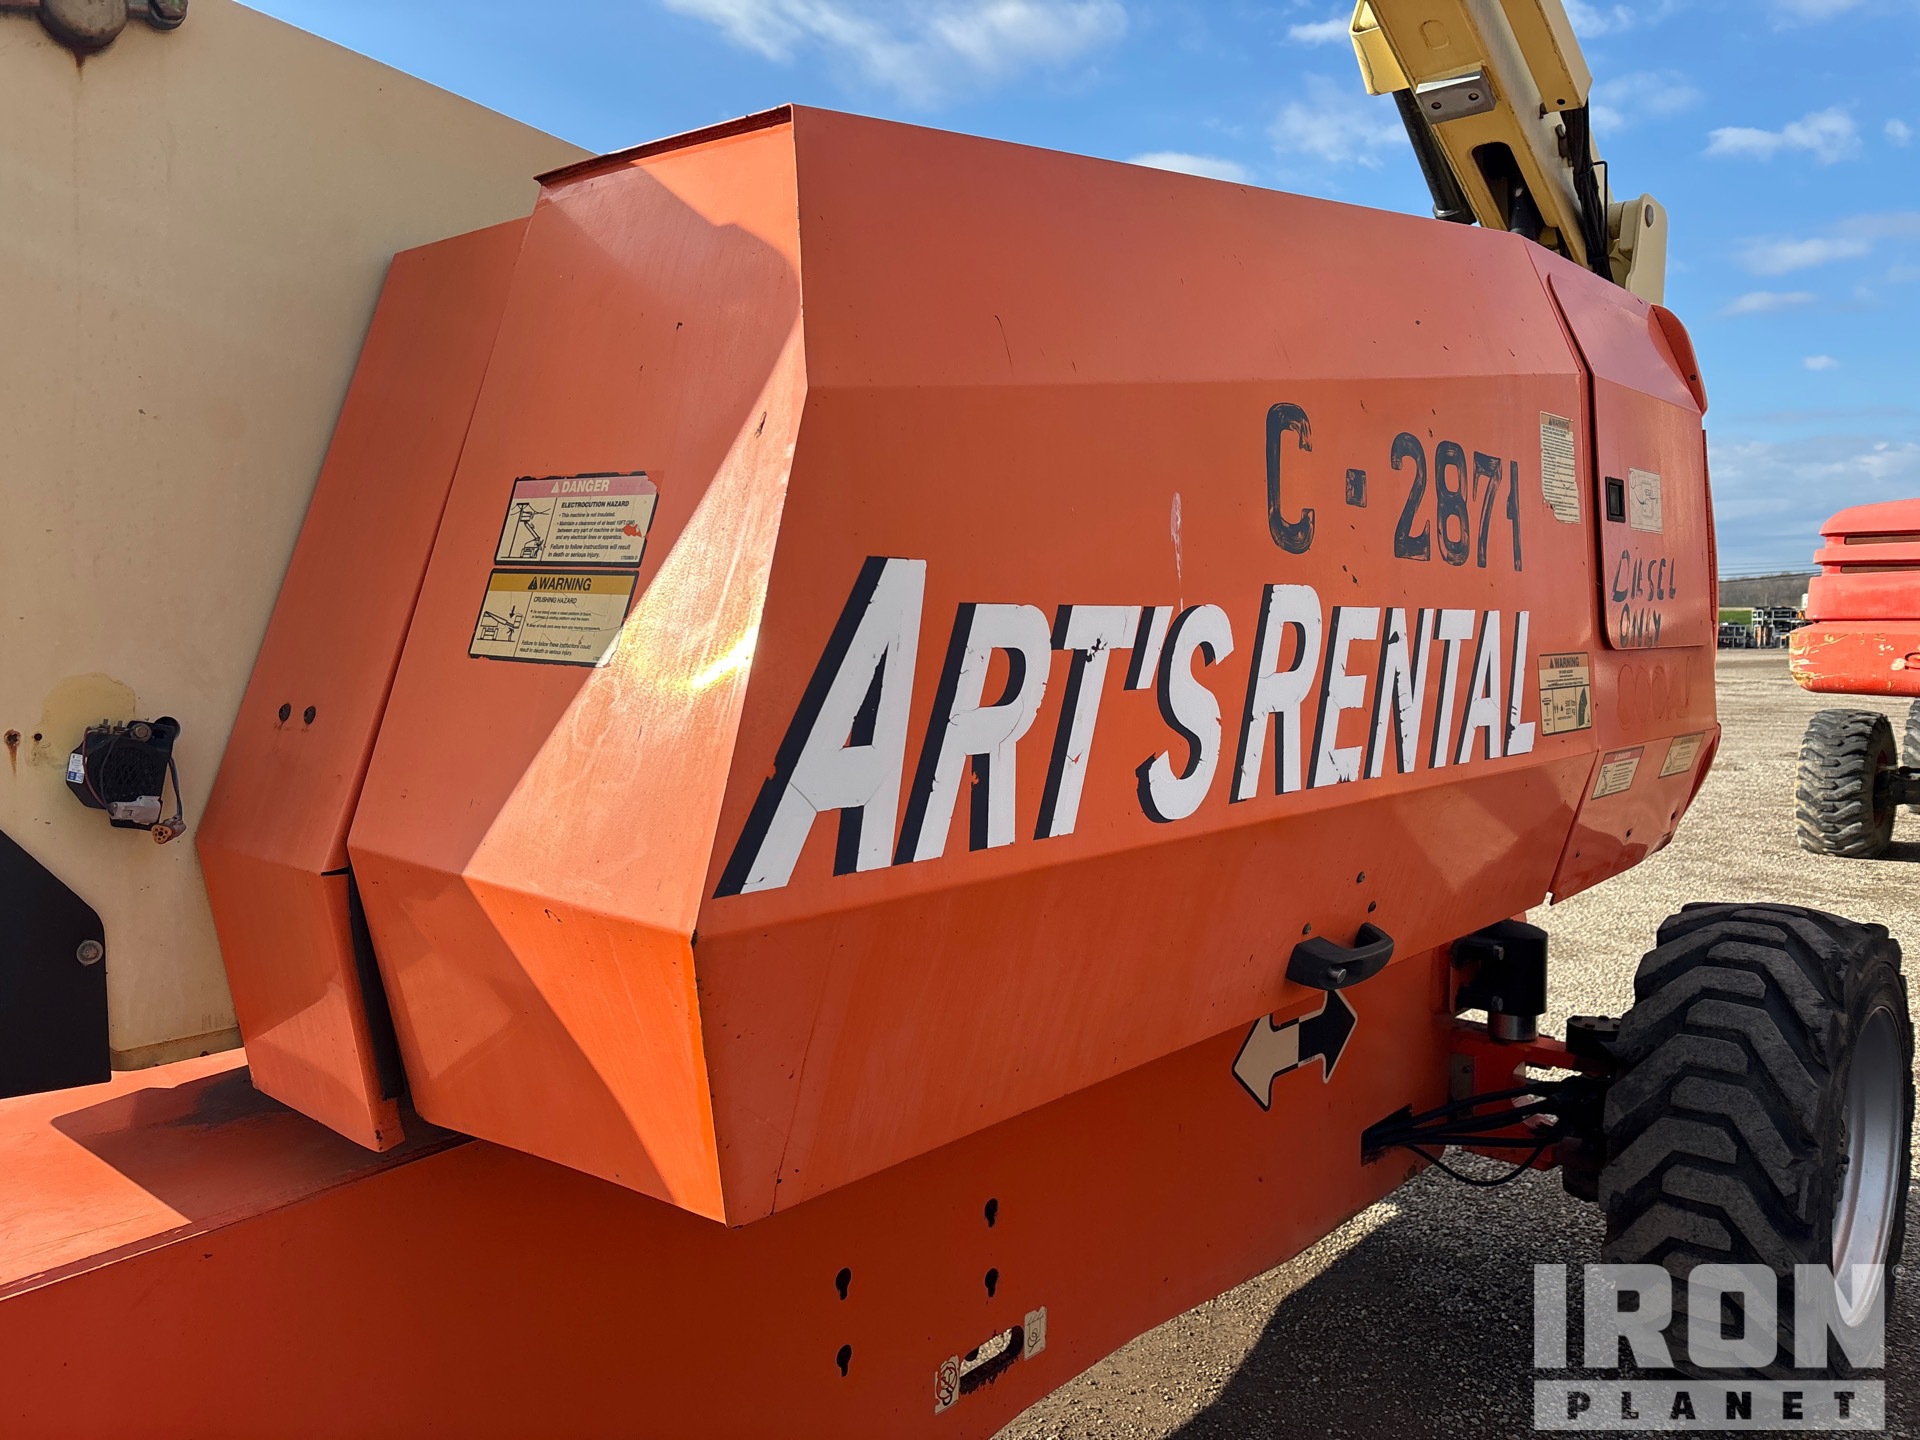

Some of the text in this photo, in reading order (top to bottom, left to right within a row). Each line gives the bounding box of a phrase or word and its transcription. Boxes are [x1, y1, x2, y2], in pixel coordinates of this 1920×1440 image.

[561, 480, 610, 493] DANGER
[1265, 402, 1315, 554] C
[1390, 432, 1523, 572] 2871
[539, 576, 592, 591] WARNING
[1620, 602, 1662, 648] ONLY
[1554, 656, 1580, 668] WARNING
[711, 555, 1537, 899] ART'S RENTAL
